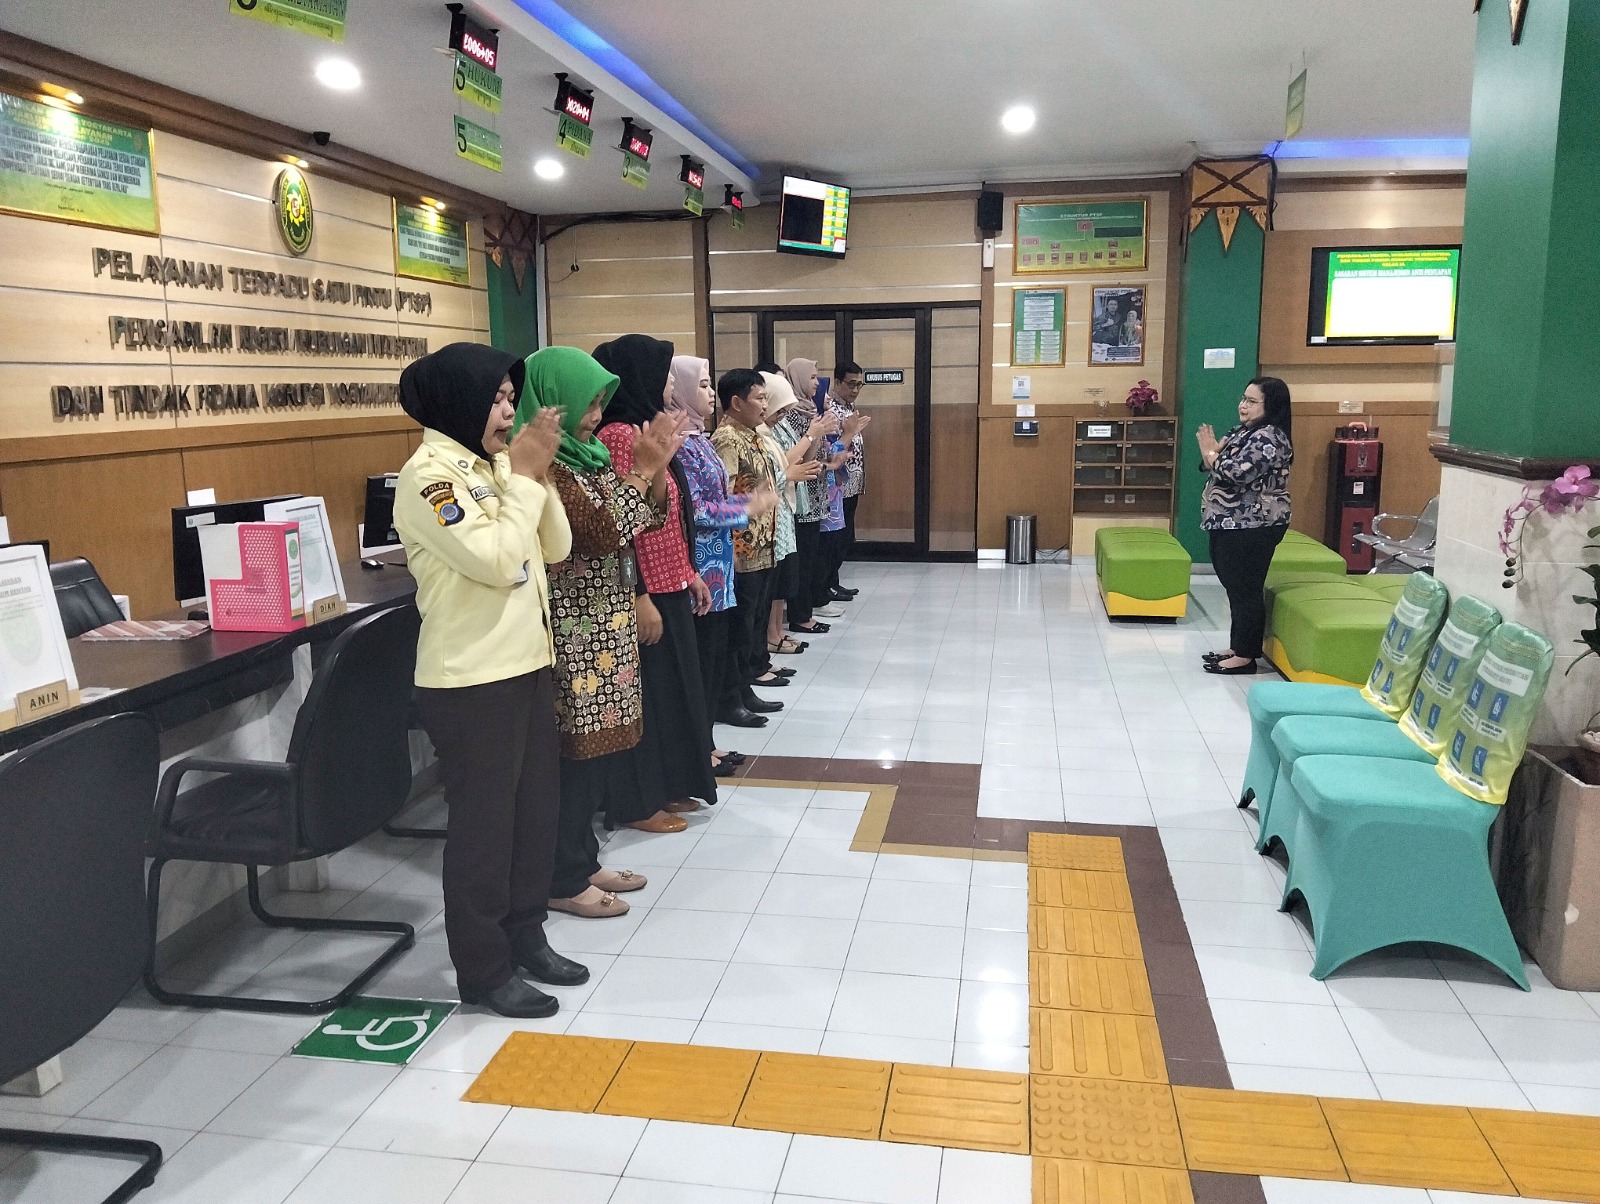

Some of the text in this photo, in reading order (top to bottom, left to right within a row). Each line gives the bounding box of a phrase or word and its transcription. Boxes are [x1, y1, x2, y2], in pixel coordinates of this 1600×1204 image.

[456, 60, 500, 94] 5 HUKUM
[457, 122, 467, 153] 5
[559, 119, 593, 145] 4 PIDANA
[92, 247, 224, 293] PELAYANAN
[228, 266, 309, 300] TERPADU
[311, 278, 350, 305] SATU
[352, 284, 391, 310] PINTU
[108, 315, 233, 353] PENGADILAN
[866, 372, 902, 381] KHUSUS PETUGAS
[51, 385, 104, 422] DAN
[108, 384, 192, 421] TINDAK
[193, 384, 259, 416] PIDANA
[260, 382, 325, 413] KORUPSI
[423, 482, 450, 496] POLDA
[30, 691, 60, 709] ANIN
